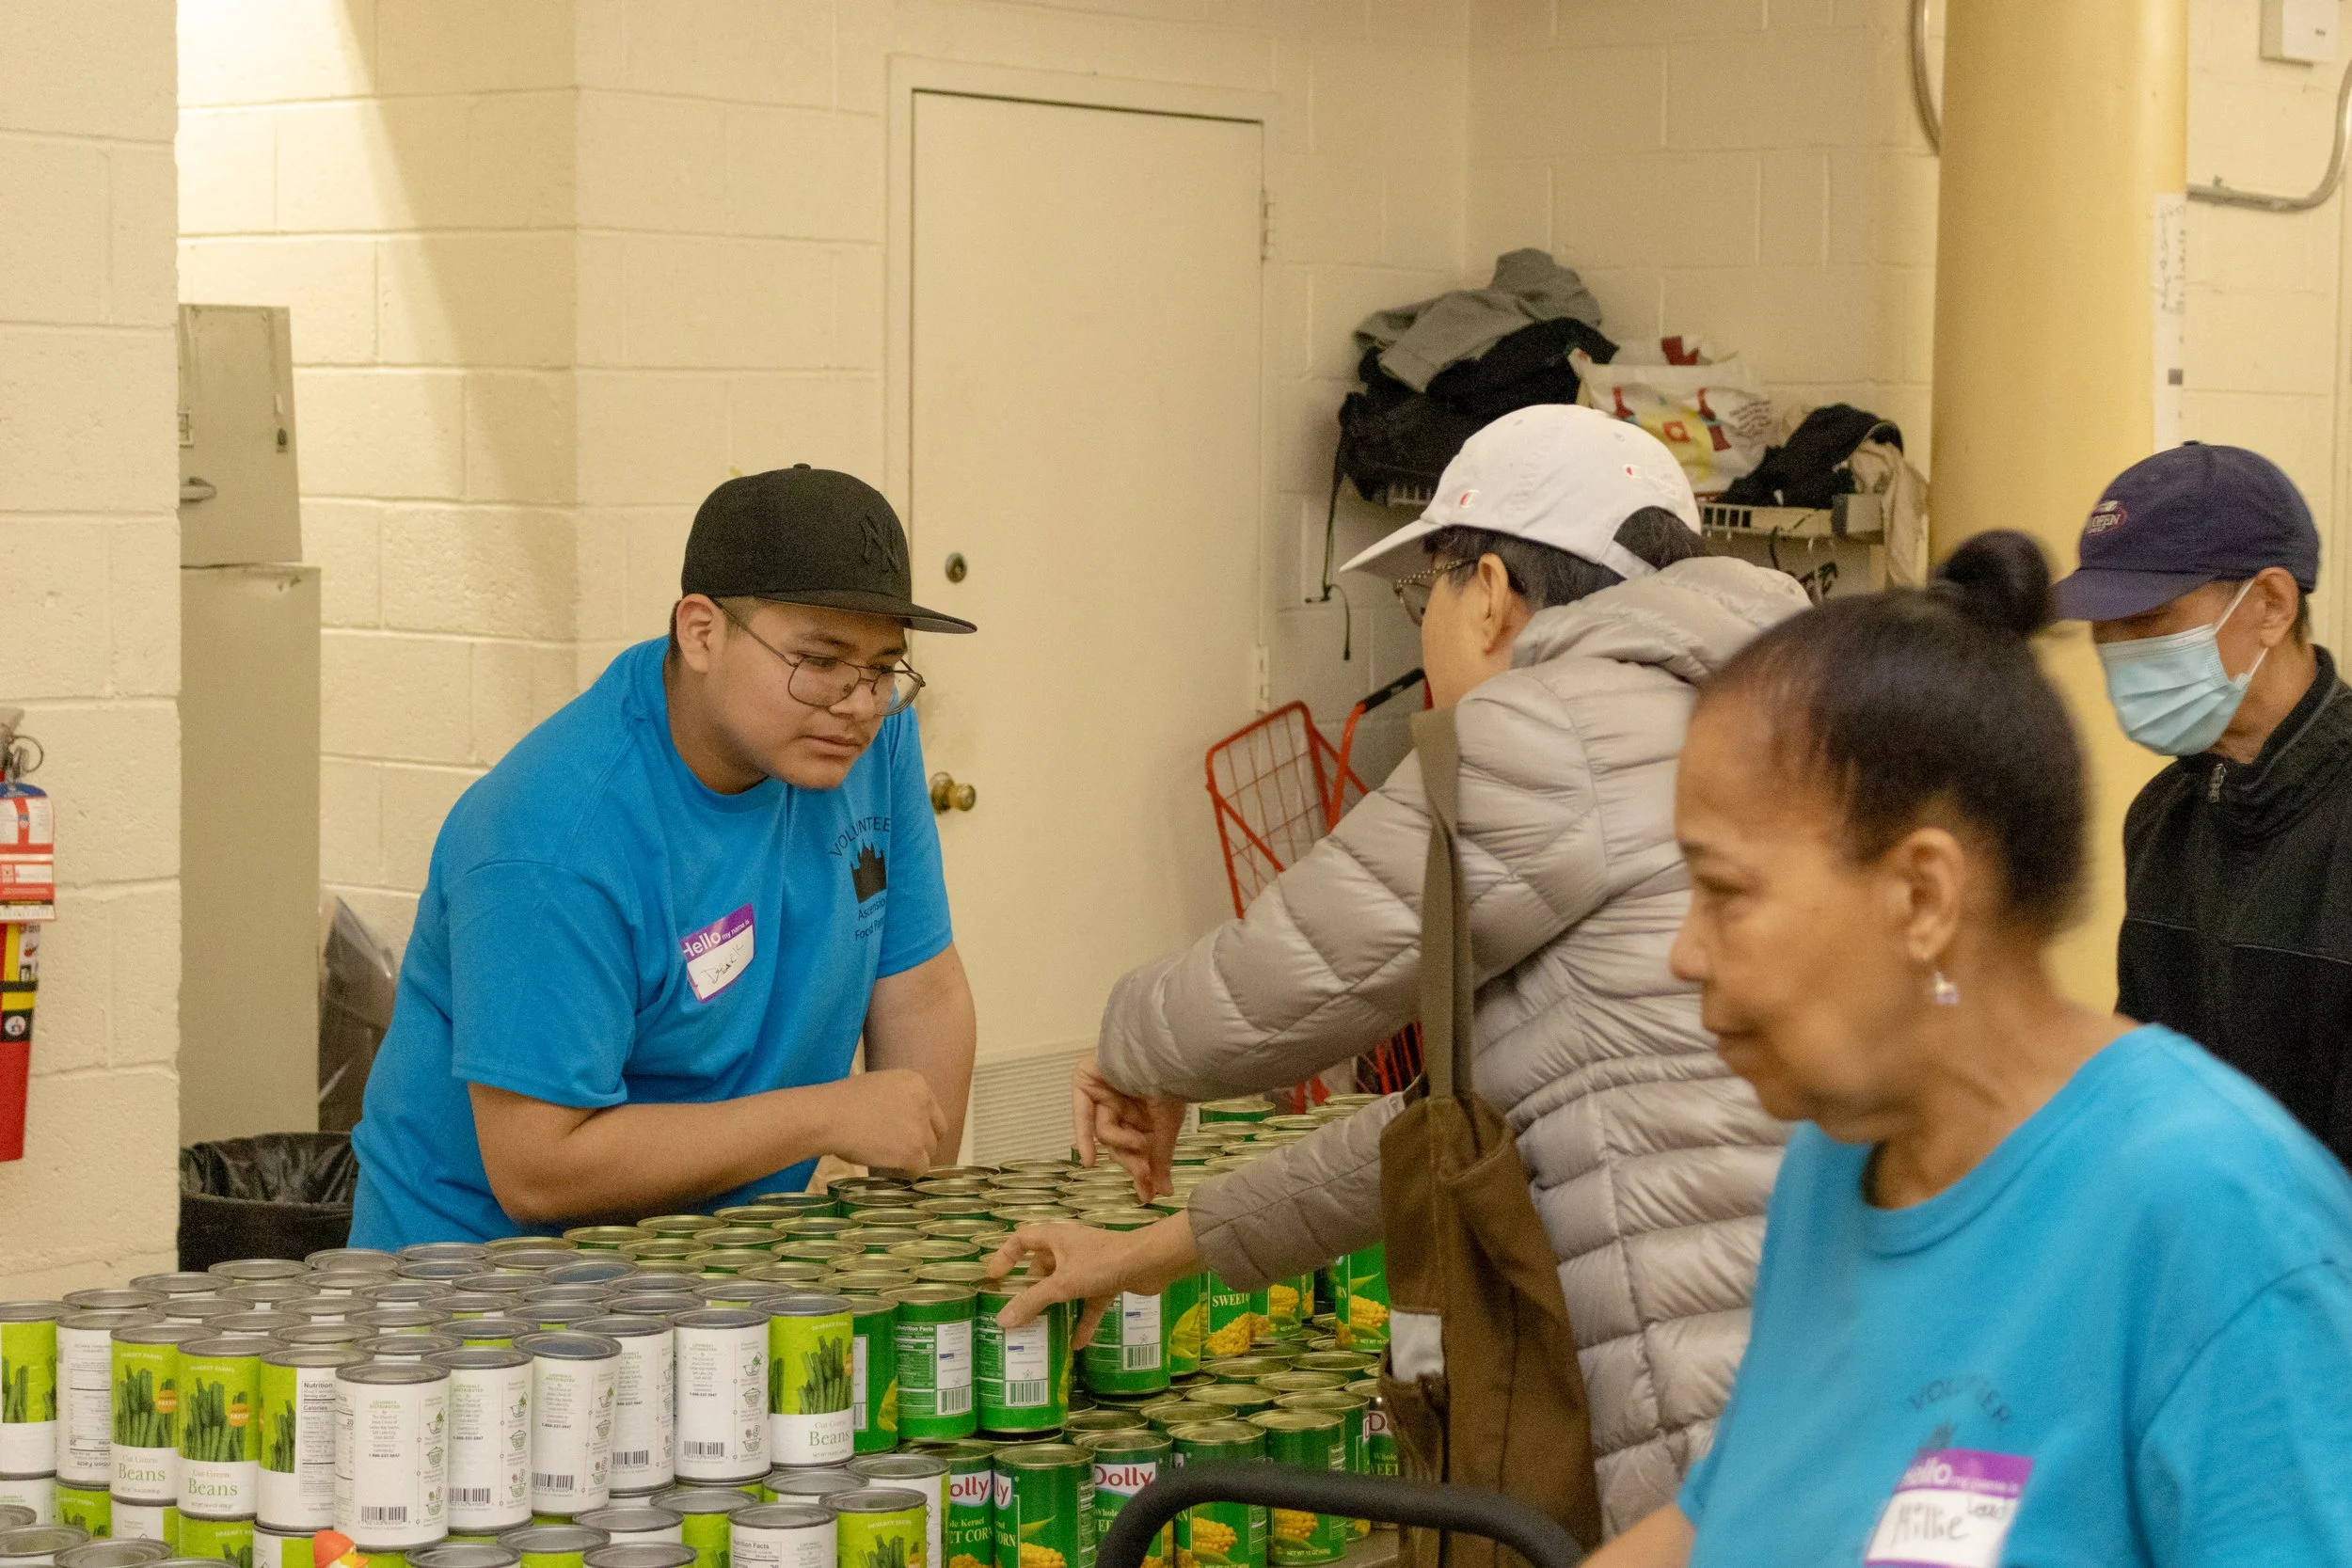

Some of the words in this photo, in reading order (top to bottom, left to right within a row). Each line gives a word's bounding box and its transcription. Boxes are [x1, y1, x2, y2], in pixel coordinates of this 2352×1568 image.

[722, 931, 731, 941] my
[731, 923, 745, 935] name
[809, 1430, 850, 1447] Beans
[119, 1463, 167, 1481] Beans
[188, 1477, 238, 1497] Beans
